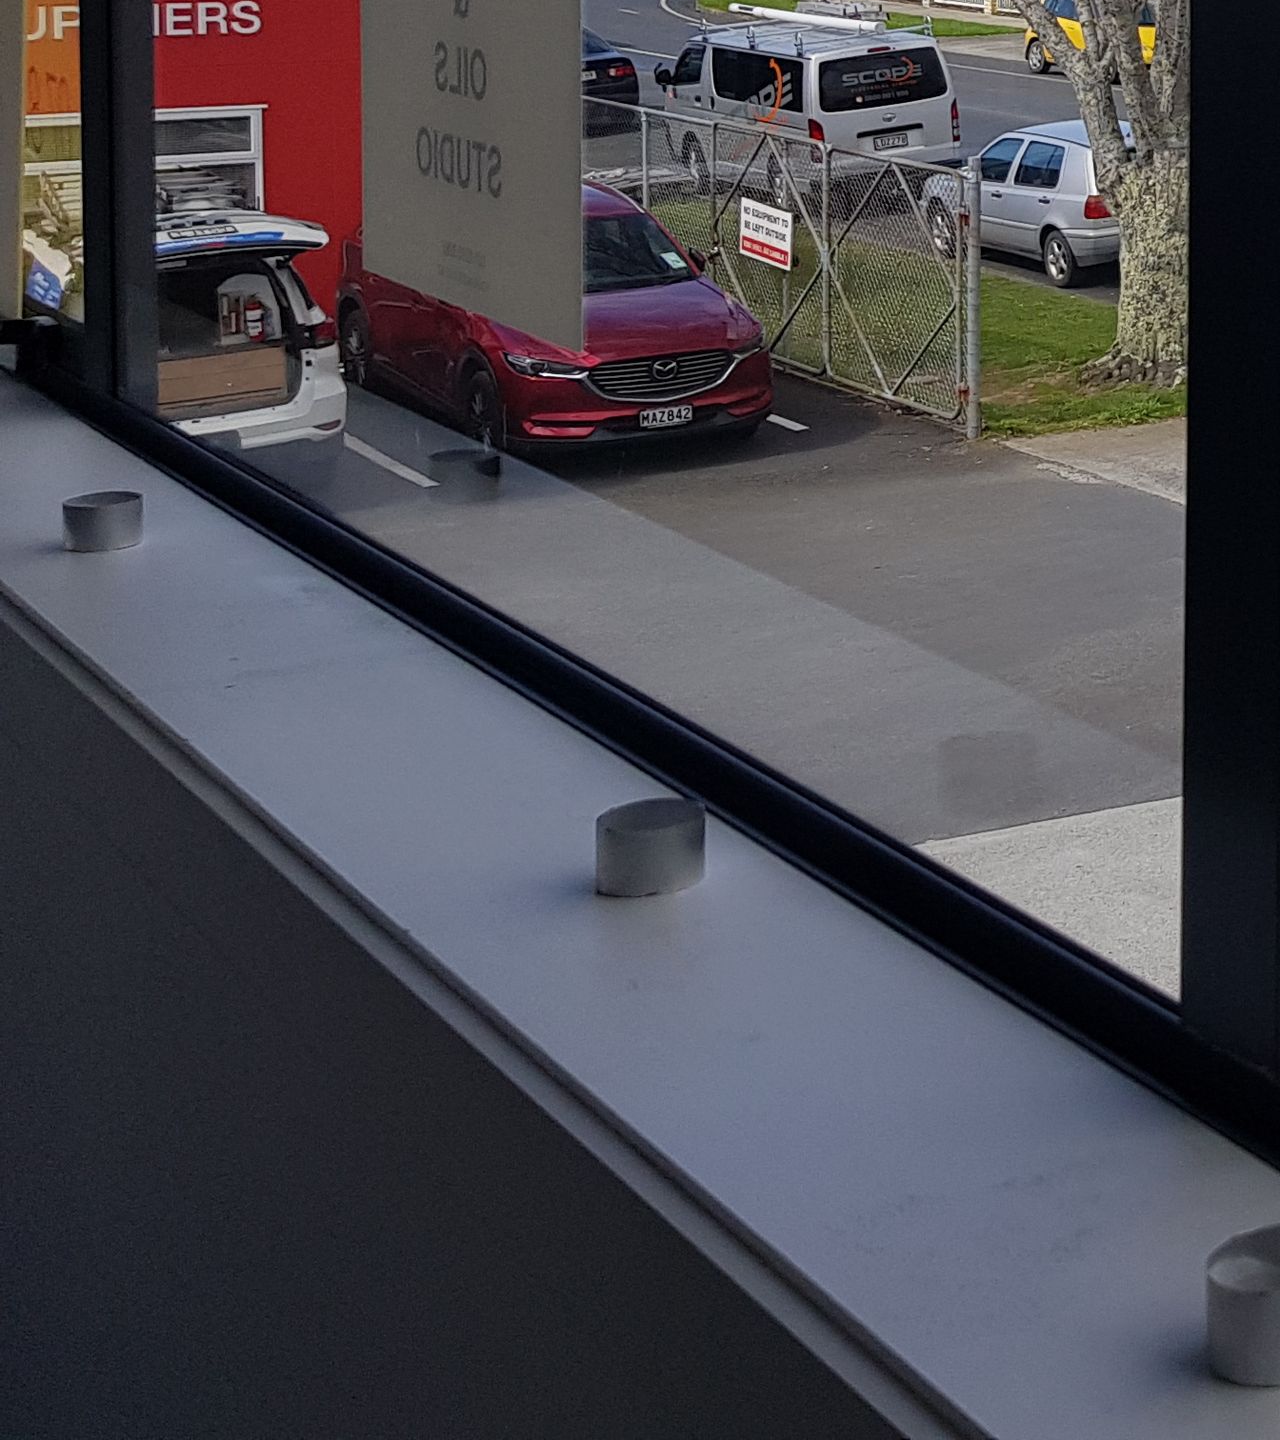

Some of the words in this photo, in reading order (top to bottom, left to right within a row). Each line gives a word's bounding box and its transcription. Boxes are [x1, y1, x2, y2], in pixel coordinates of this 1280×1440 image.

[841, 63, 923, 87] SCOPE
[781, 218, 789, 229] TO
[641, 407, 691, 425] MAZ842
